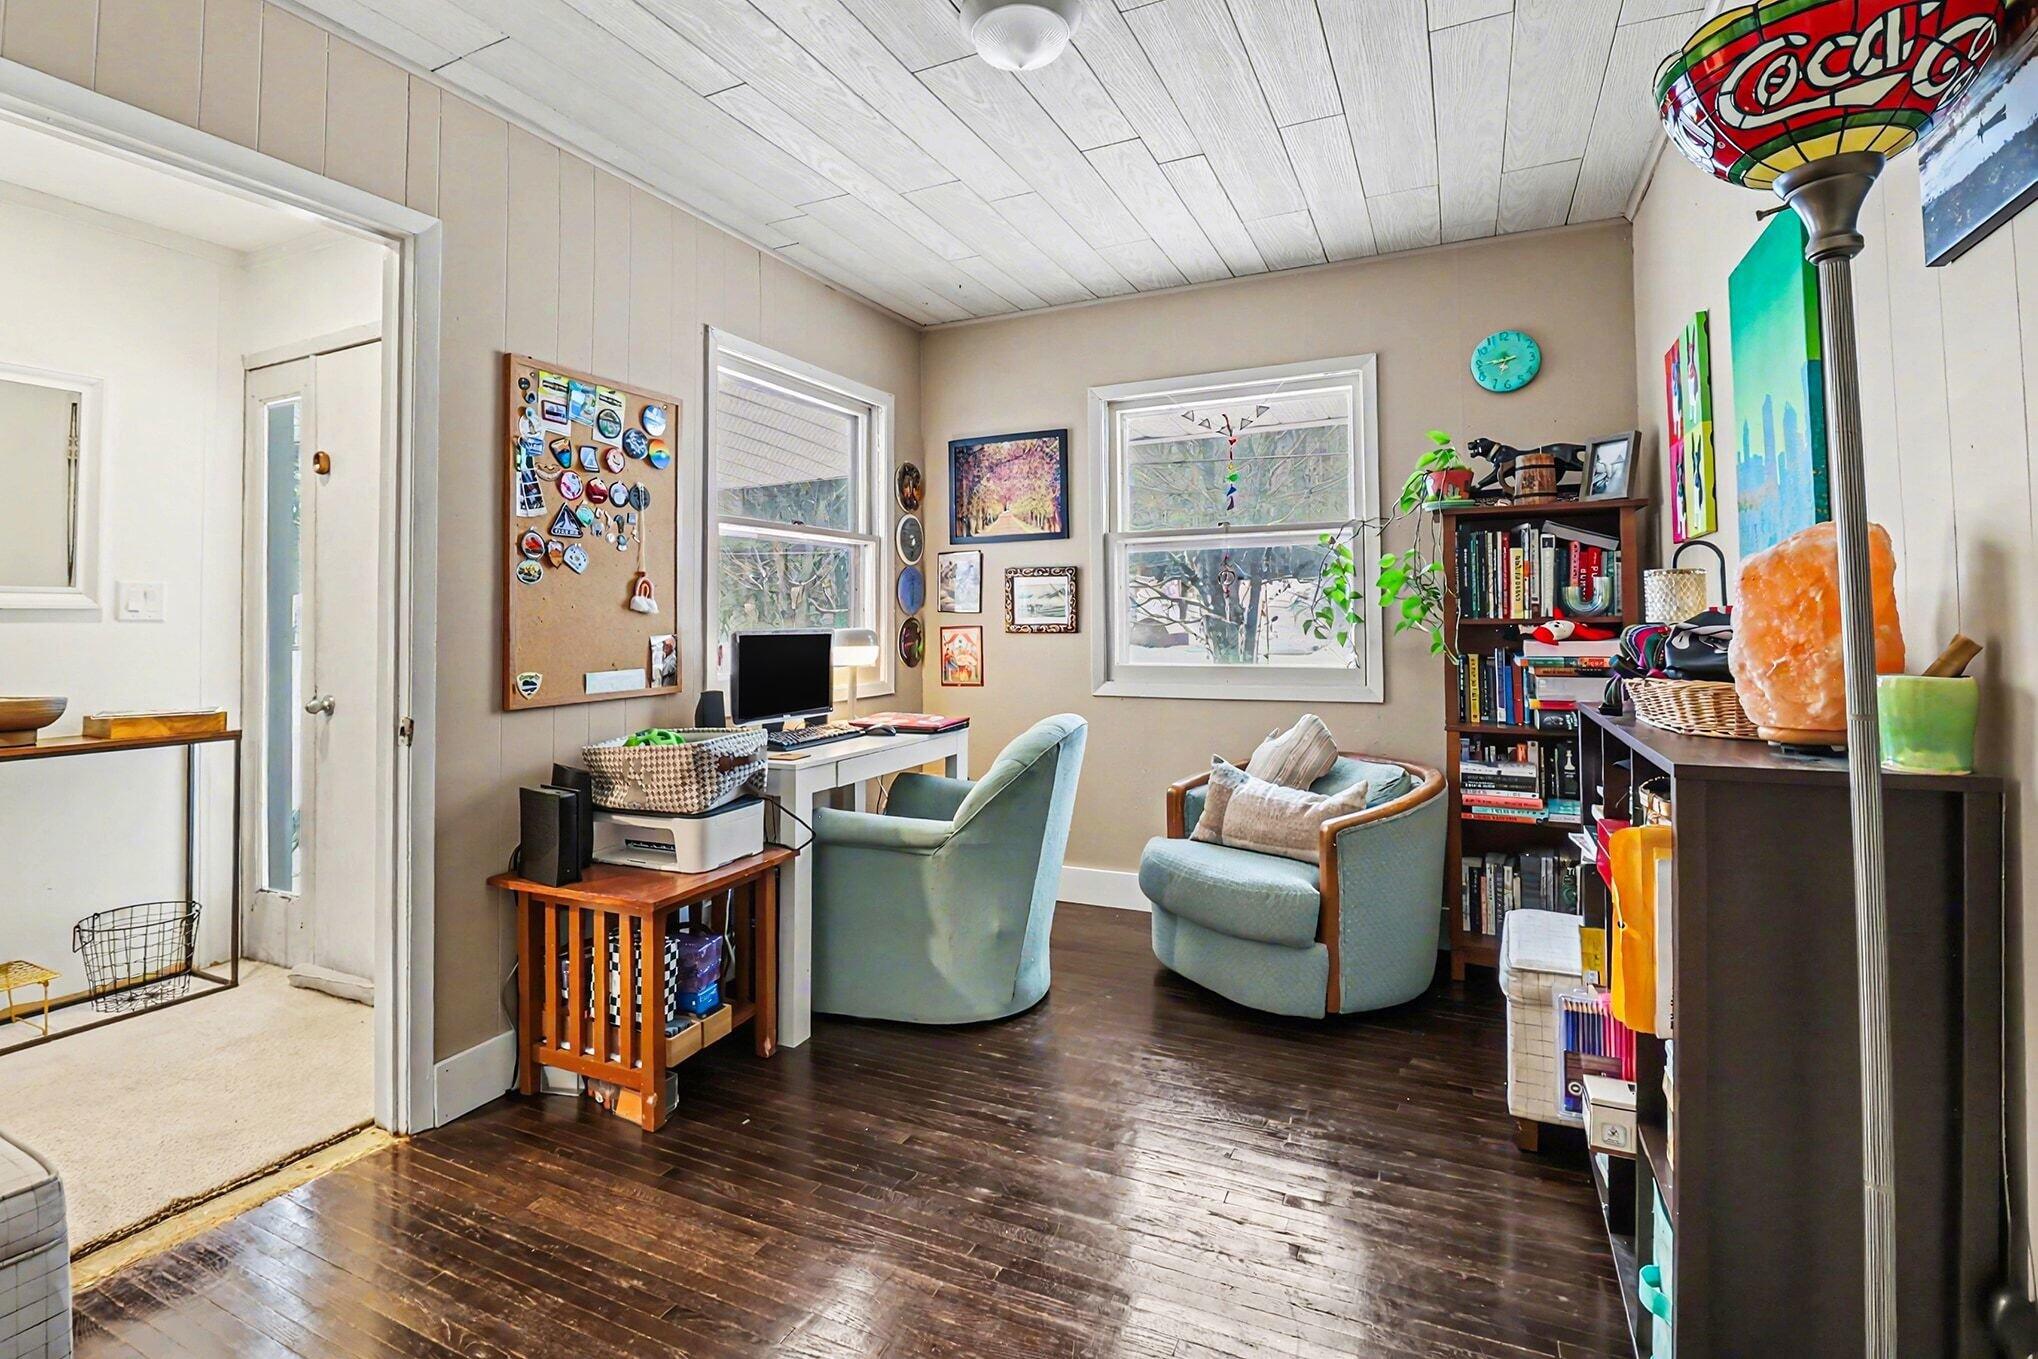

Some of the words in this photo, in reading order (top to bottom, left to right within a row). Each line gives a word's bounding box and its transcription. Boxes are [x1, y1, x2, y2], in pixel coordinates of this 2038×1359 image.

[1527, 338, 1534, 348] 2
[1477, 346, 1488, 357] 10
[1529, 351, 1536, 362] 3
[1503, 379, 1512, 389] 6
